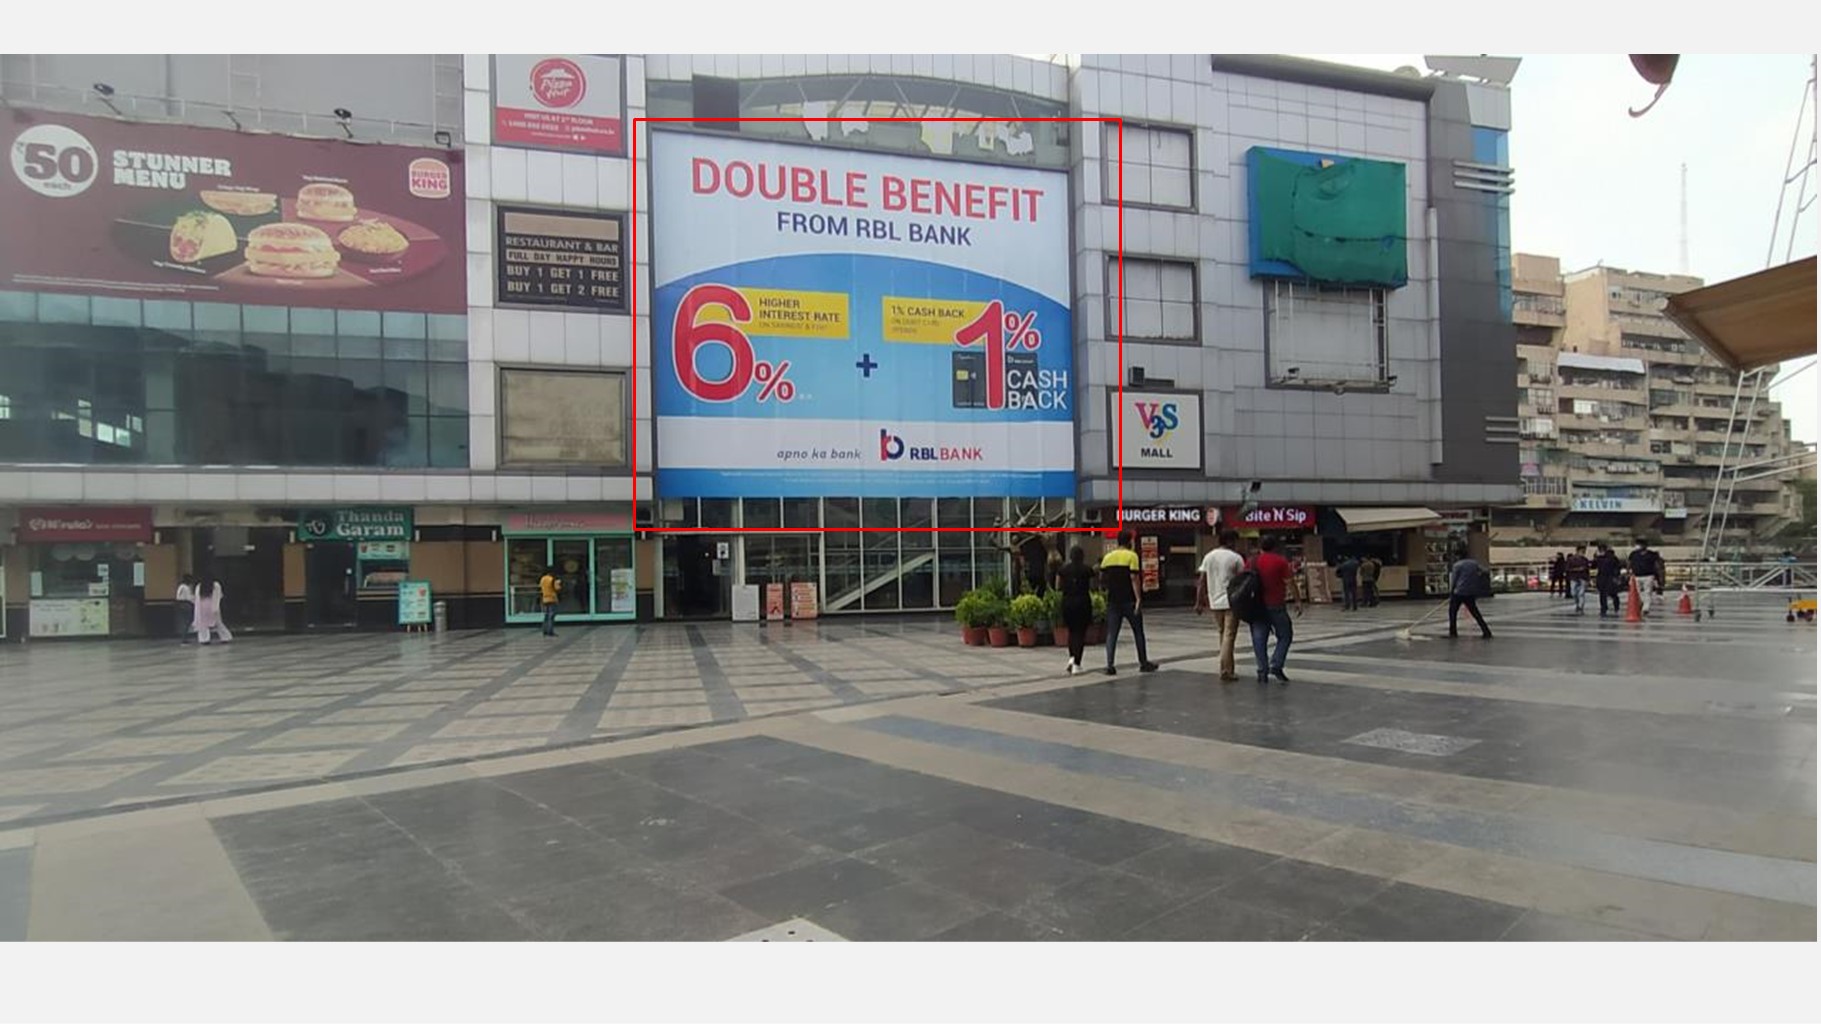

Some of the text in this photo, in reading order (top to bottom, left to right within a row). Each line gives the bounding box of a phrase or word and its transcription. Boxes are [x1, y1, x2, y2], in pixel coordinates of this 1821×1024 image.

[113, 150, 231, 177] STUNNER
[114, 167, 186, 190] MENU
[411, 178, 448, 190] KING
[692, 157, 1044, 222] DOUBLE BENEFIT
[777, 211, 971, 246] FROM RBL BANK
[505, 236, 618, 253] RESTAURANT & BAR
[508, 251, 529, 260] FULL
[534, 252, 551, 260] DAY
[507, 265, 619, 282] BUY 1 GET 1 FREE
[507, 281, 619, 298] BUY 1 GET 2 FREE
[759, 298, 800, 309] HIGHER
[759, 310, 842, 323] INTEREST RATE
[892, 305, 965, 318] 1% CASH BACK
[1007, 370, 1067, 389] CASH
[1007, 390, 1067, 410] BACK
[777, 448, 861, 460] apno ka bank
[1141, 448, 1173, 458] MALL
[1580, 498, 1622, 509] KELVIN
[337, 509, 404, 522] Thanda
[1169, 509, 1200, 521] KING
[1286, 508, 1306, 524] Sip
[337, 522, 404, 536] Garam
